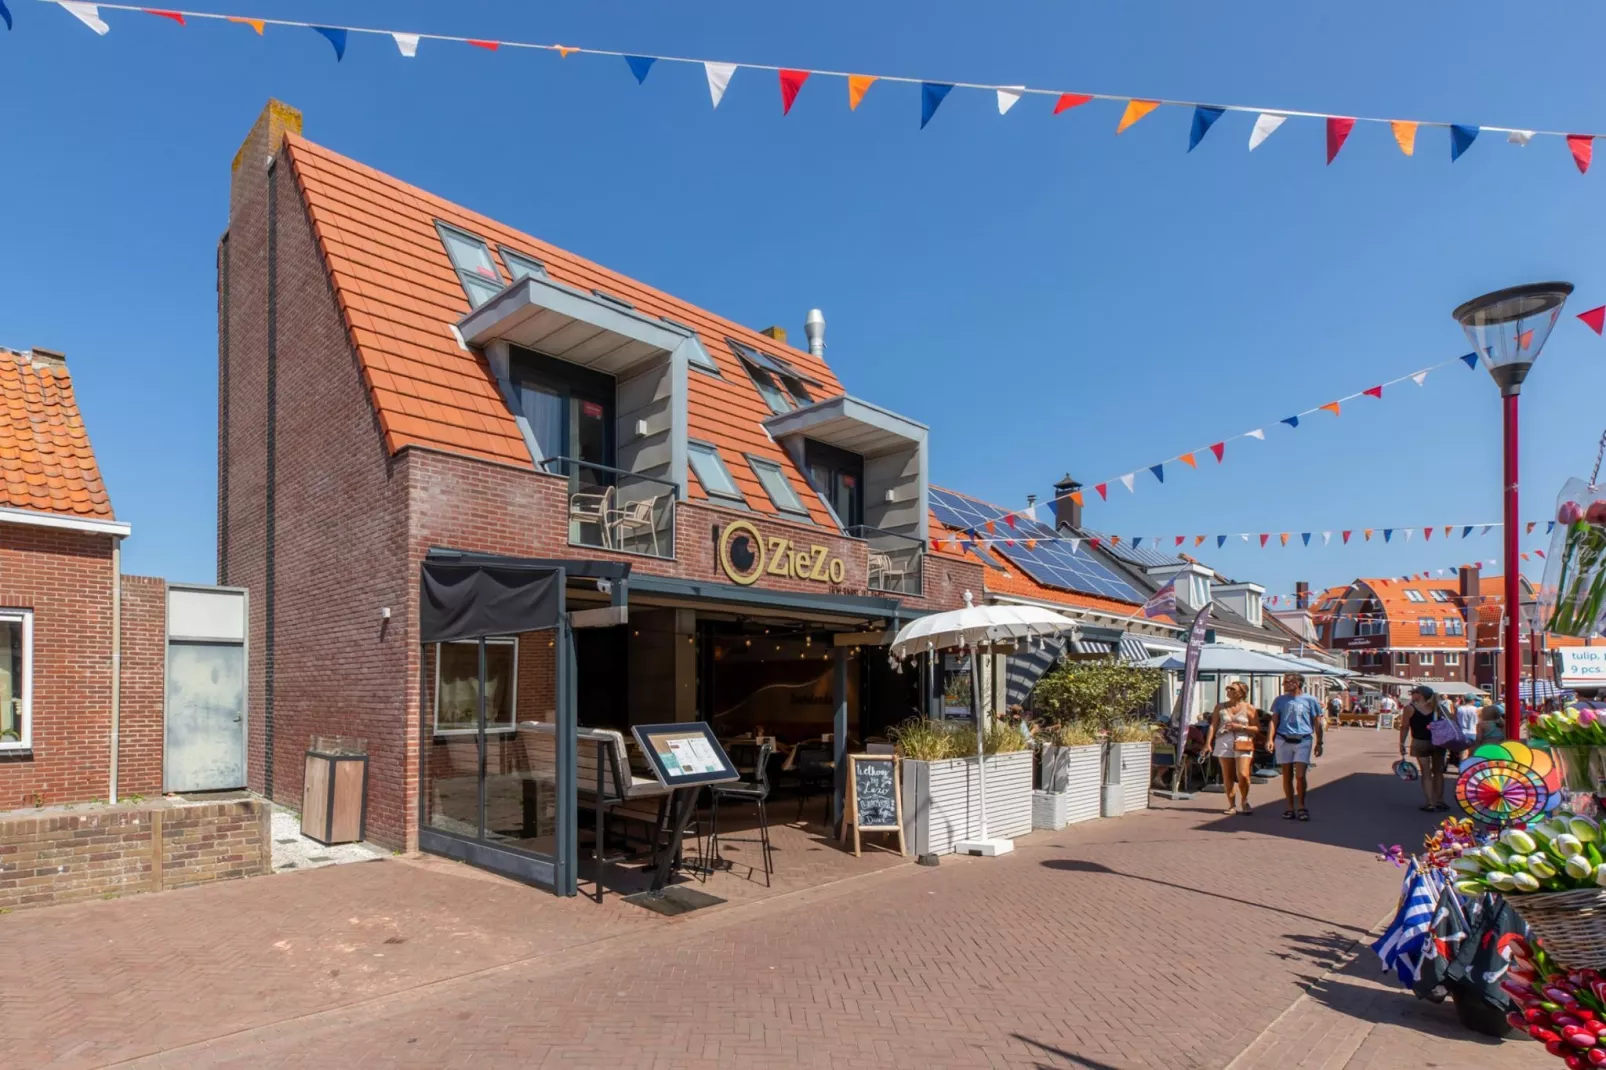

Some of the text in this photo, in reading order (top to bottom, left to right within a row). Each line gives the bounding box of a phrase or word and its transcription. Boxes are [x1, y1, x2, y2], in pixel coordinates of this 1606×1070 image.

[767, 536, 845, 584] ZieZo
[1572, 652, 1601, 661] tulip,
[1571, 665, 1604, 674] 9 pcs.
